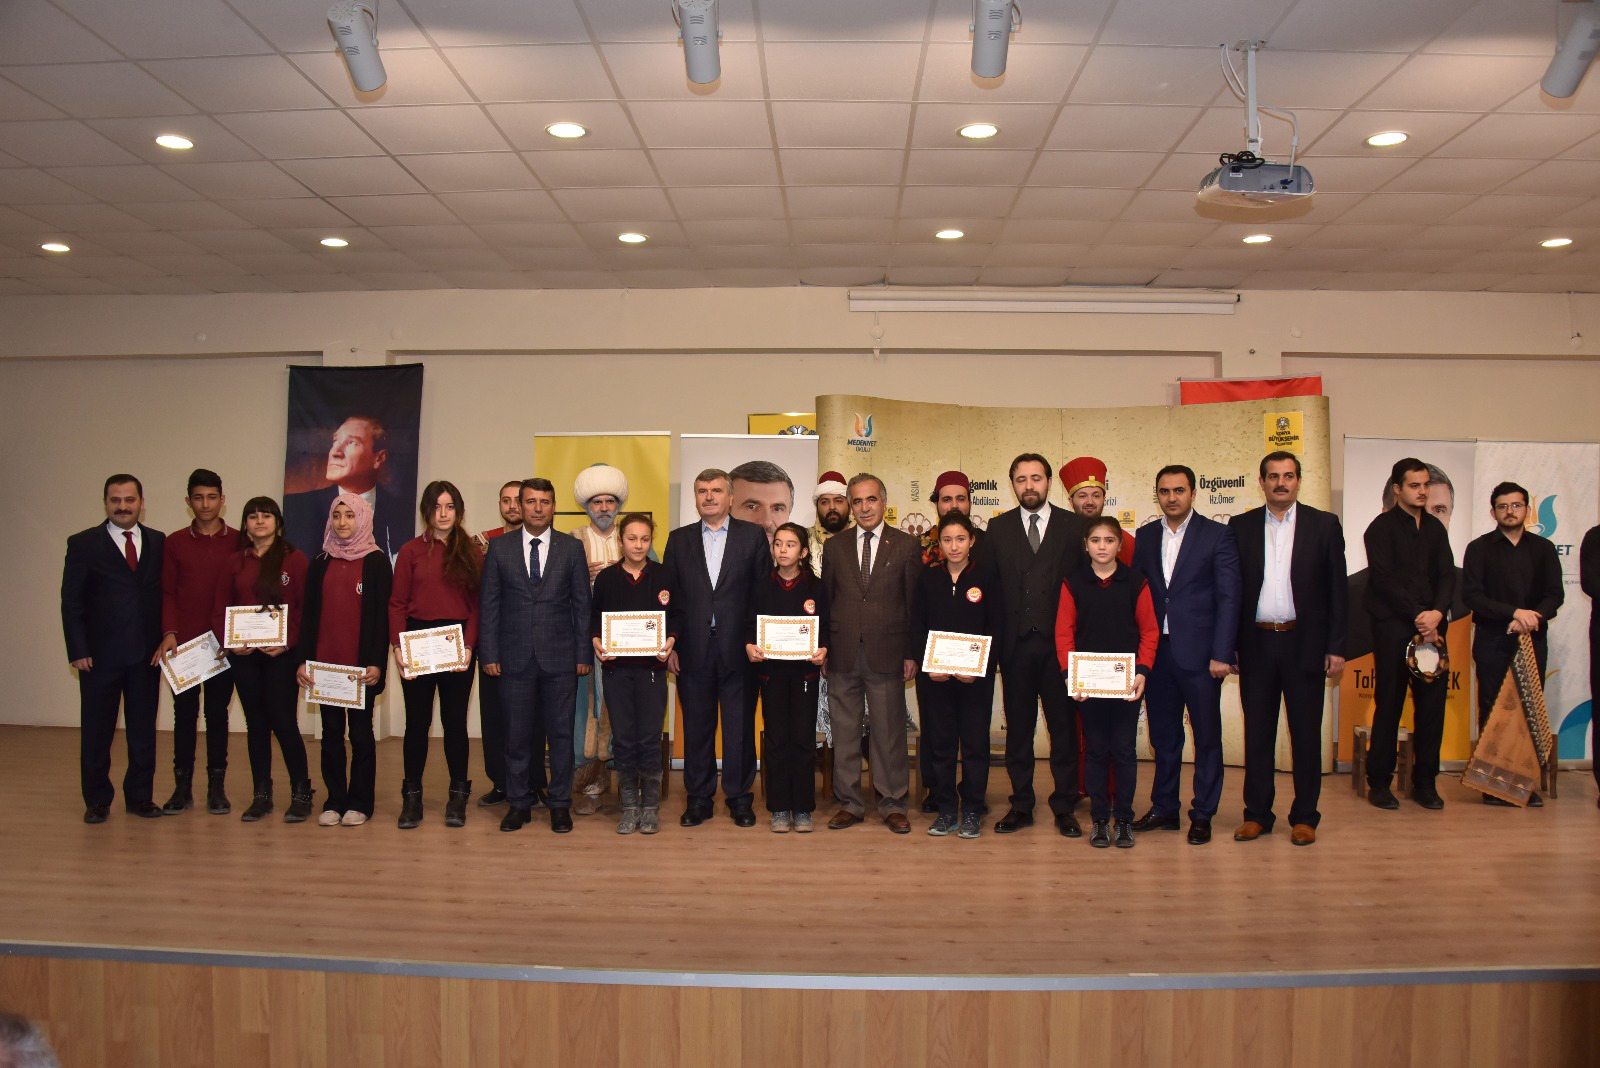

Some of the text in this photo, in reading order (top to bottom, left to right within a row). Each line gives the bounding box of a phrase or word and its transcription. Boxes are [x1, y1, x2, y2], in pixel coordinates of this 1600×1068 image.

[910, 480, 920, 502] KASIM
[1200, 475, 1245, 493] Özgüvenli
[972, 496, 1000, 506] Abdülaziz
[1209, 493, 1235, 505] Hz.Ömer
